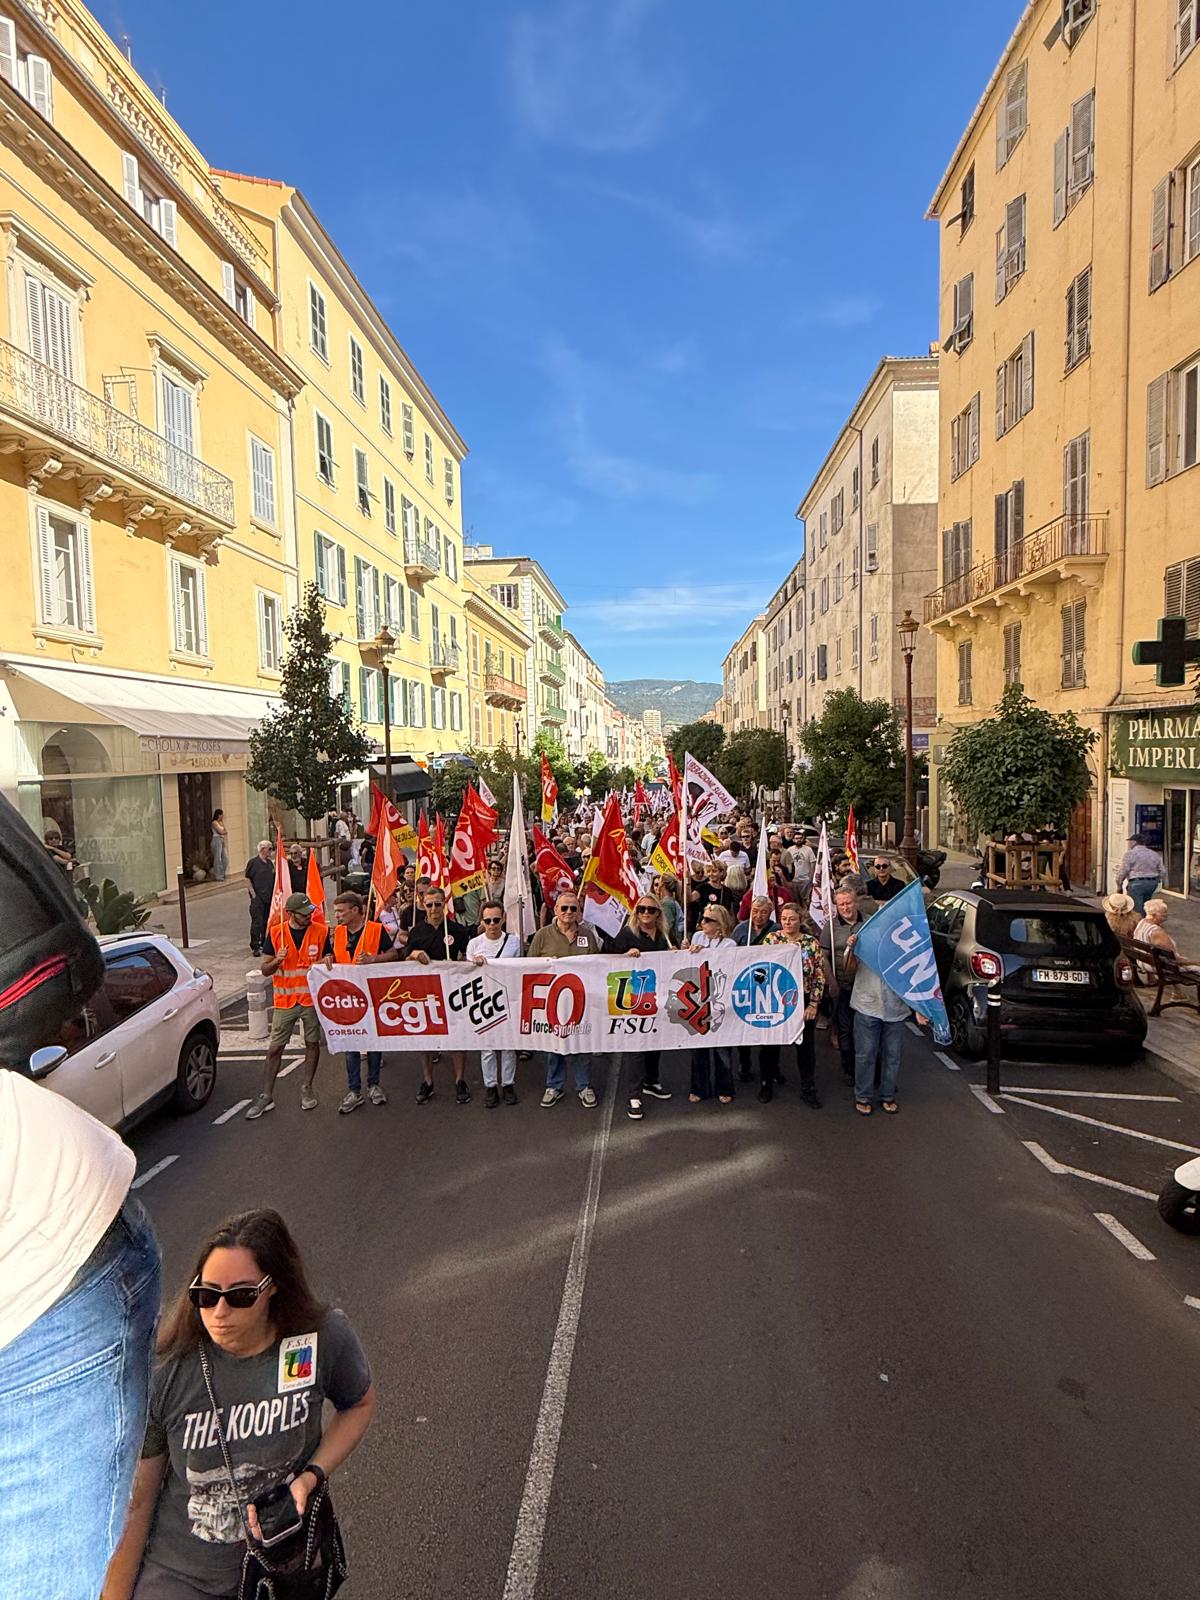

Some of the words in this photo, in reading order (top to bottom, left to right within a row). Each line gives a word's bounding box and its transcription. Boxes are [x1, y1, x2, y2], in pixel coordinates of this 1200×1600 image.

[1128, 747, 1200, 770] IMPERI
[448, 975, 484, 1013] CFE
[468, 989, 506, 1026] CGC
[520, 973, 586, 1038] FO
[377, 994, 444, 1033] cgt
[521, 1018, 530, 1033] la
[532, 1019, 553, 1034] force
[608, 1017, 657, 1035] FSU.
[328, 1028, 369, 1037] CORSICA
[183, 1408, 224, 1450] THE
[226, 1391, 311, 1442] KOOPLES
